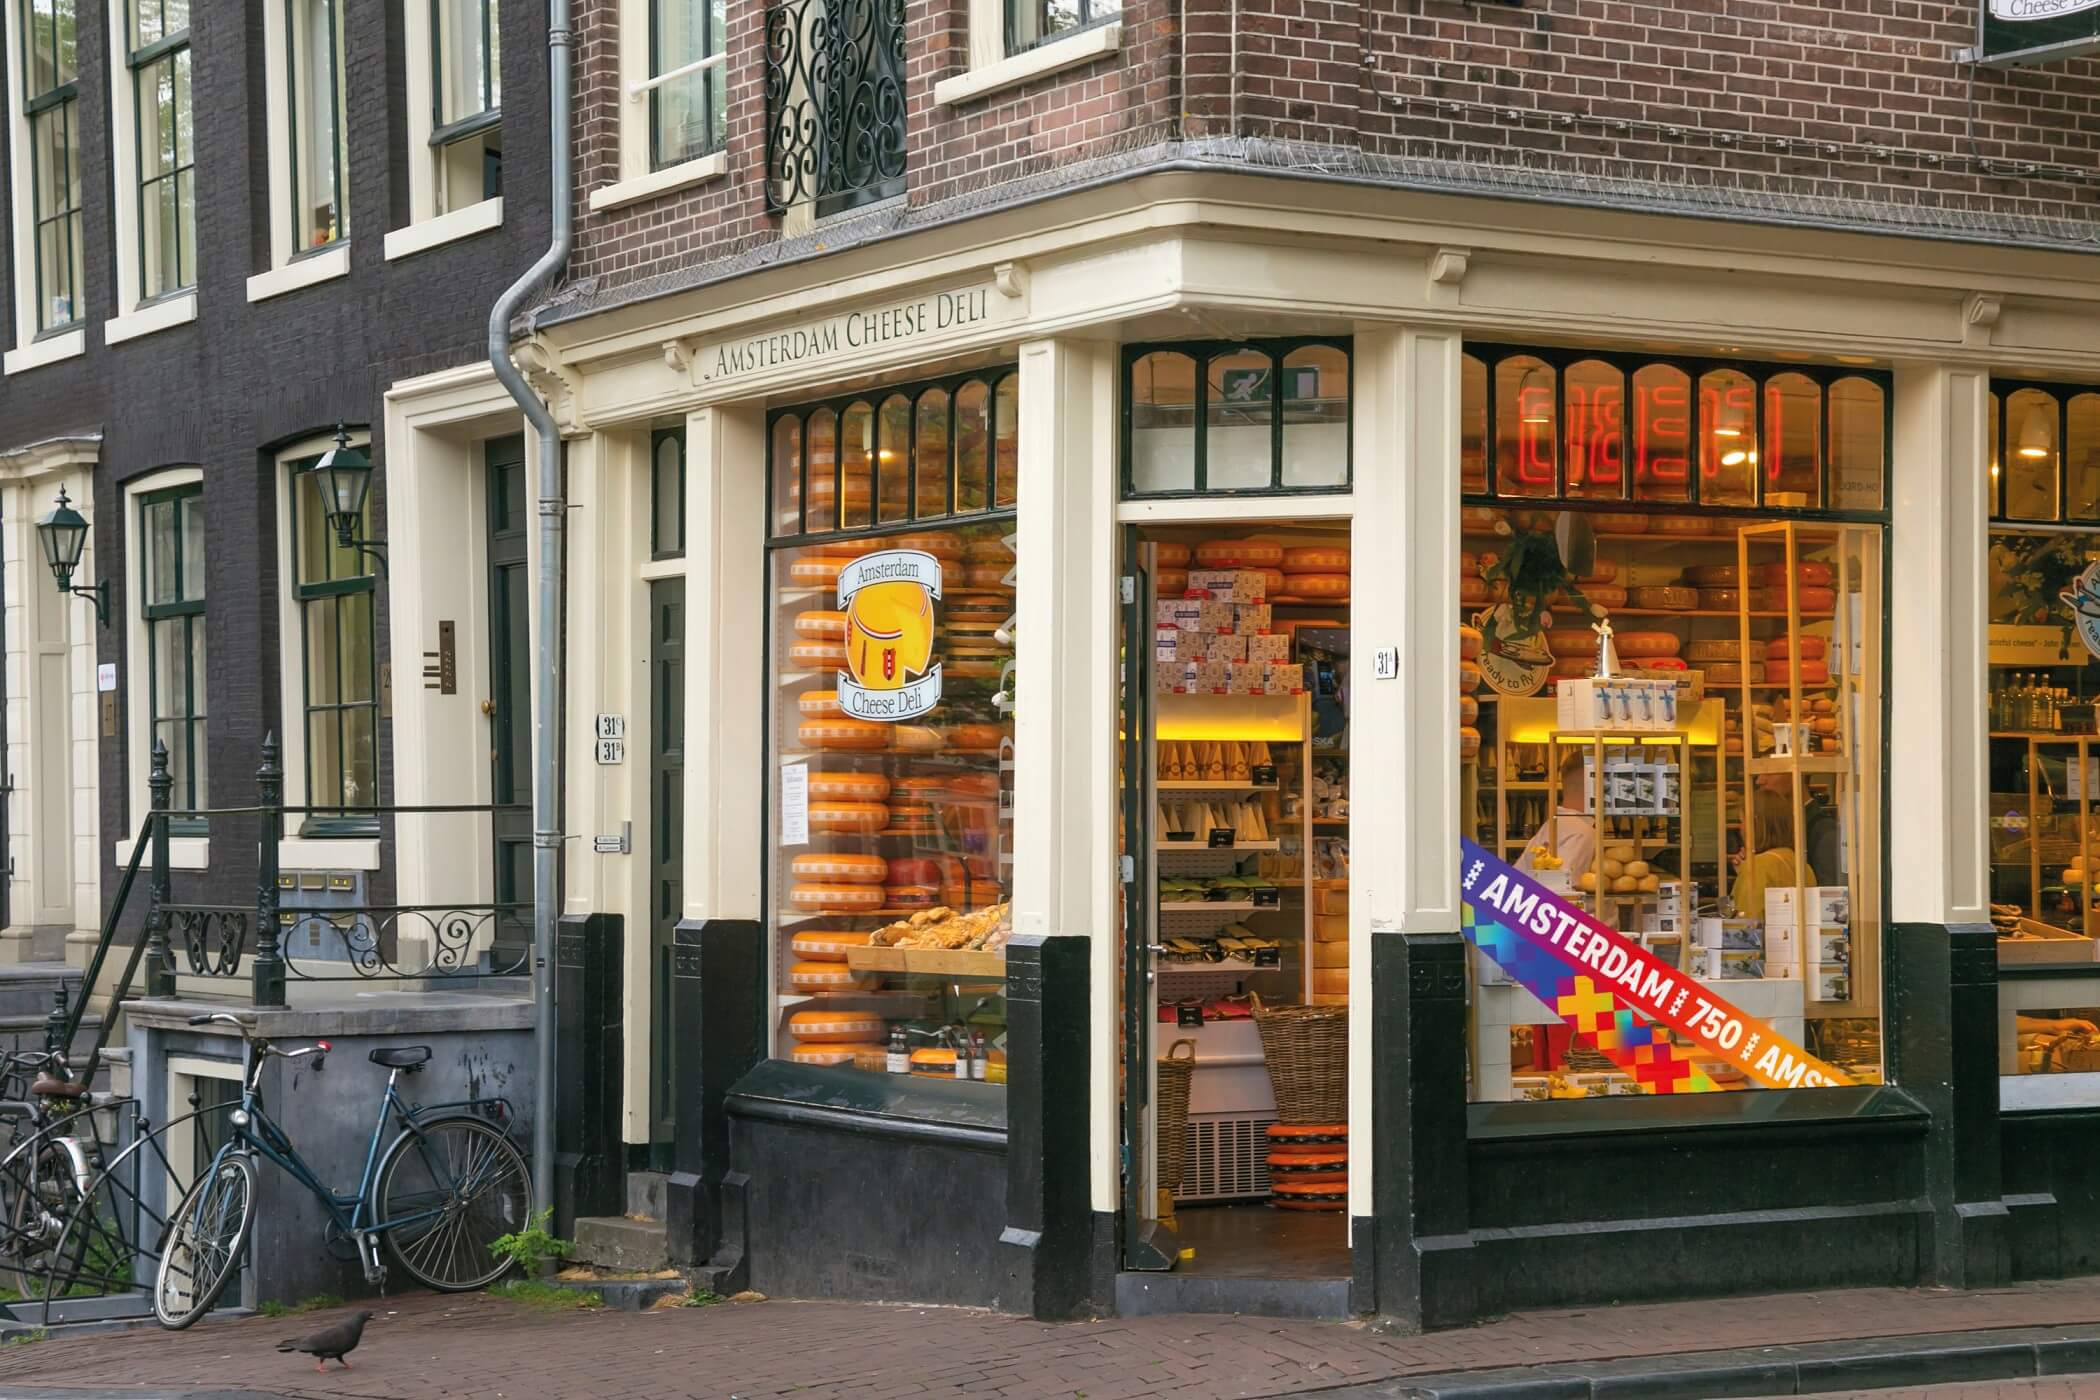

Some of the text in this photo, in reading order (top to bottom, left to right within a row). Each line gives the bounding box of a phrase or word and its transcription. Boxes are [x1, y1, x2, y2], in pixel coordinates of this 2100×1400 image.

[857, 557, 919, 585] Amsterdam
[1508, 680, 1520, 689] to
[853, 687, 922, 715] Cheese Deli
[1479, 873, 1675, 1008] AMSTERDAM
[1685, 998, 1743, 1050] 750
